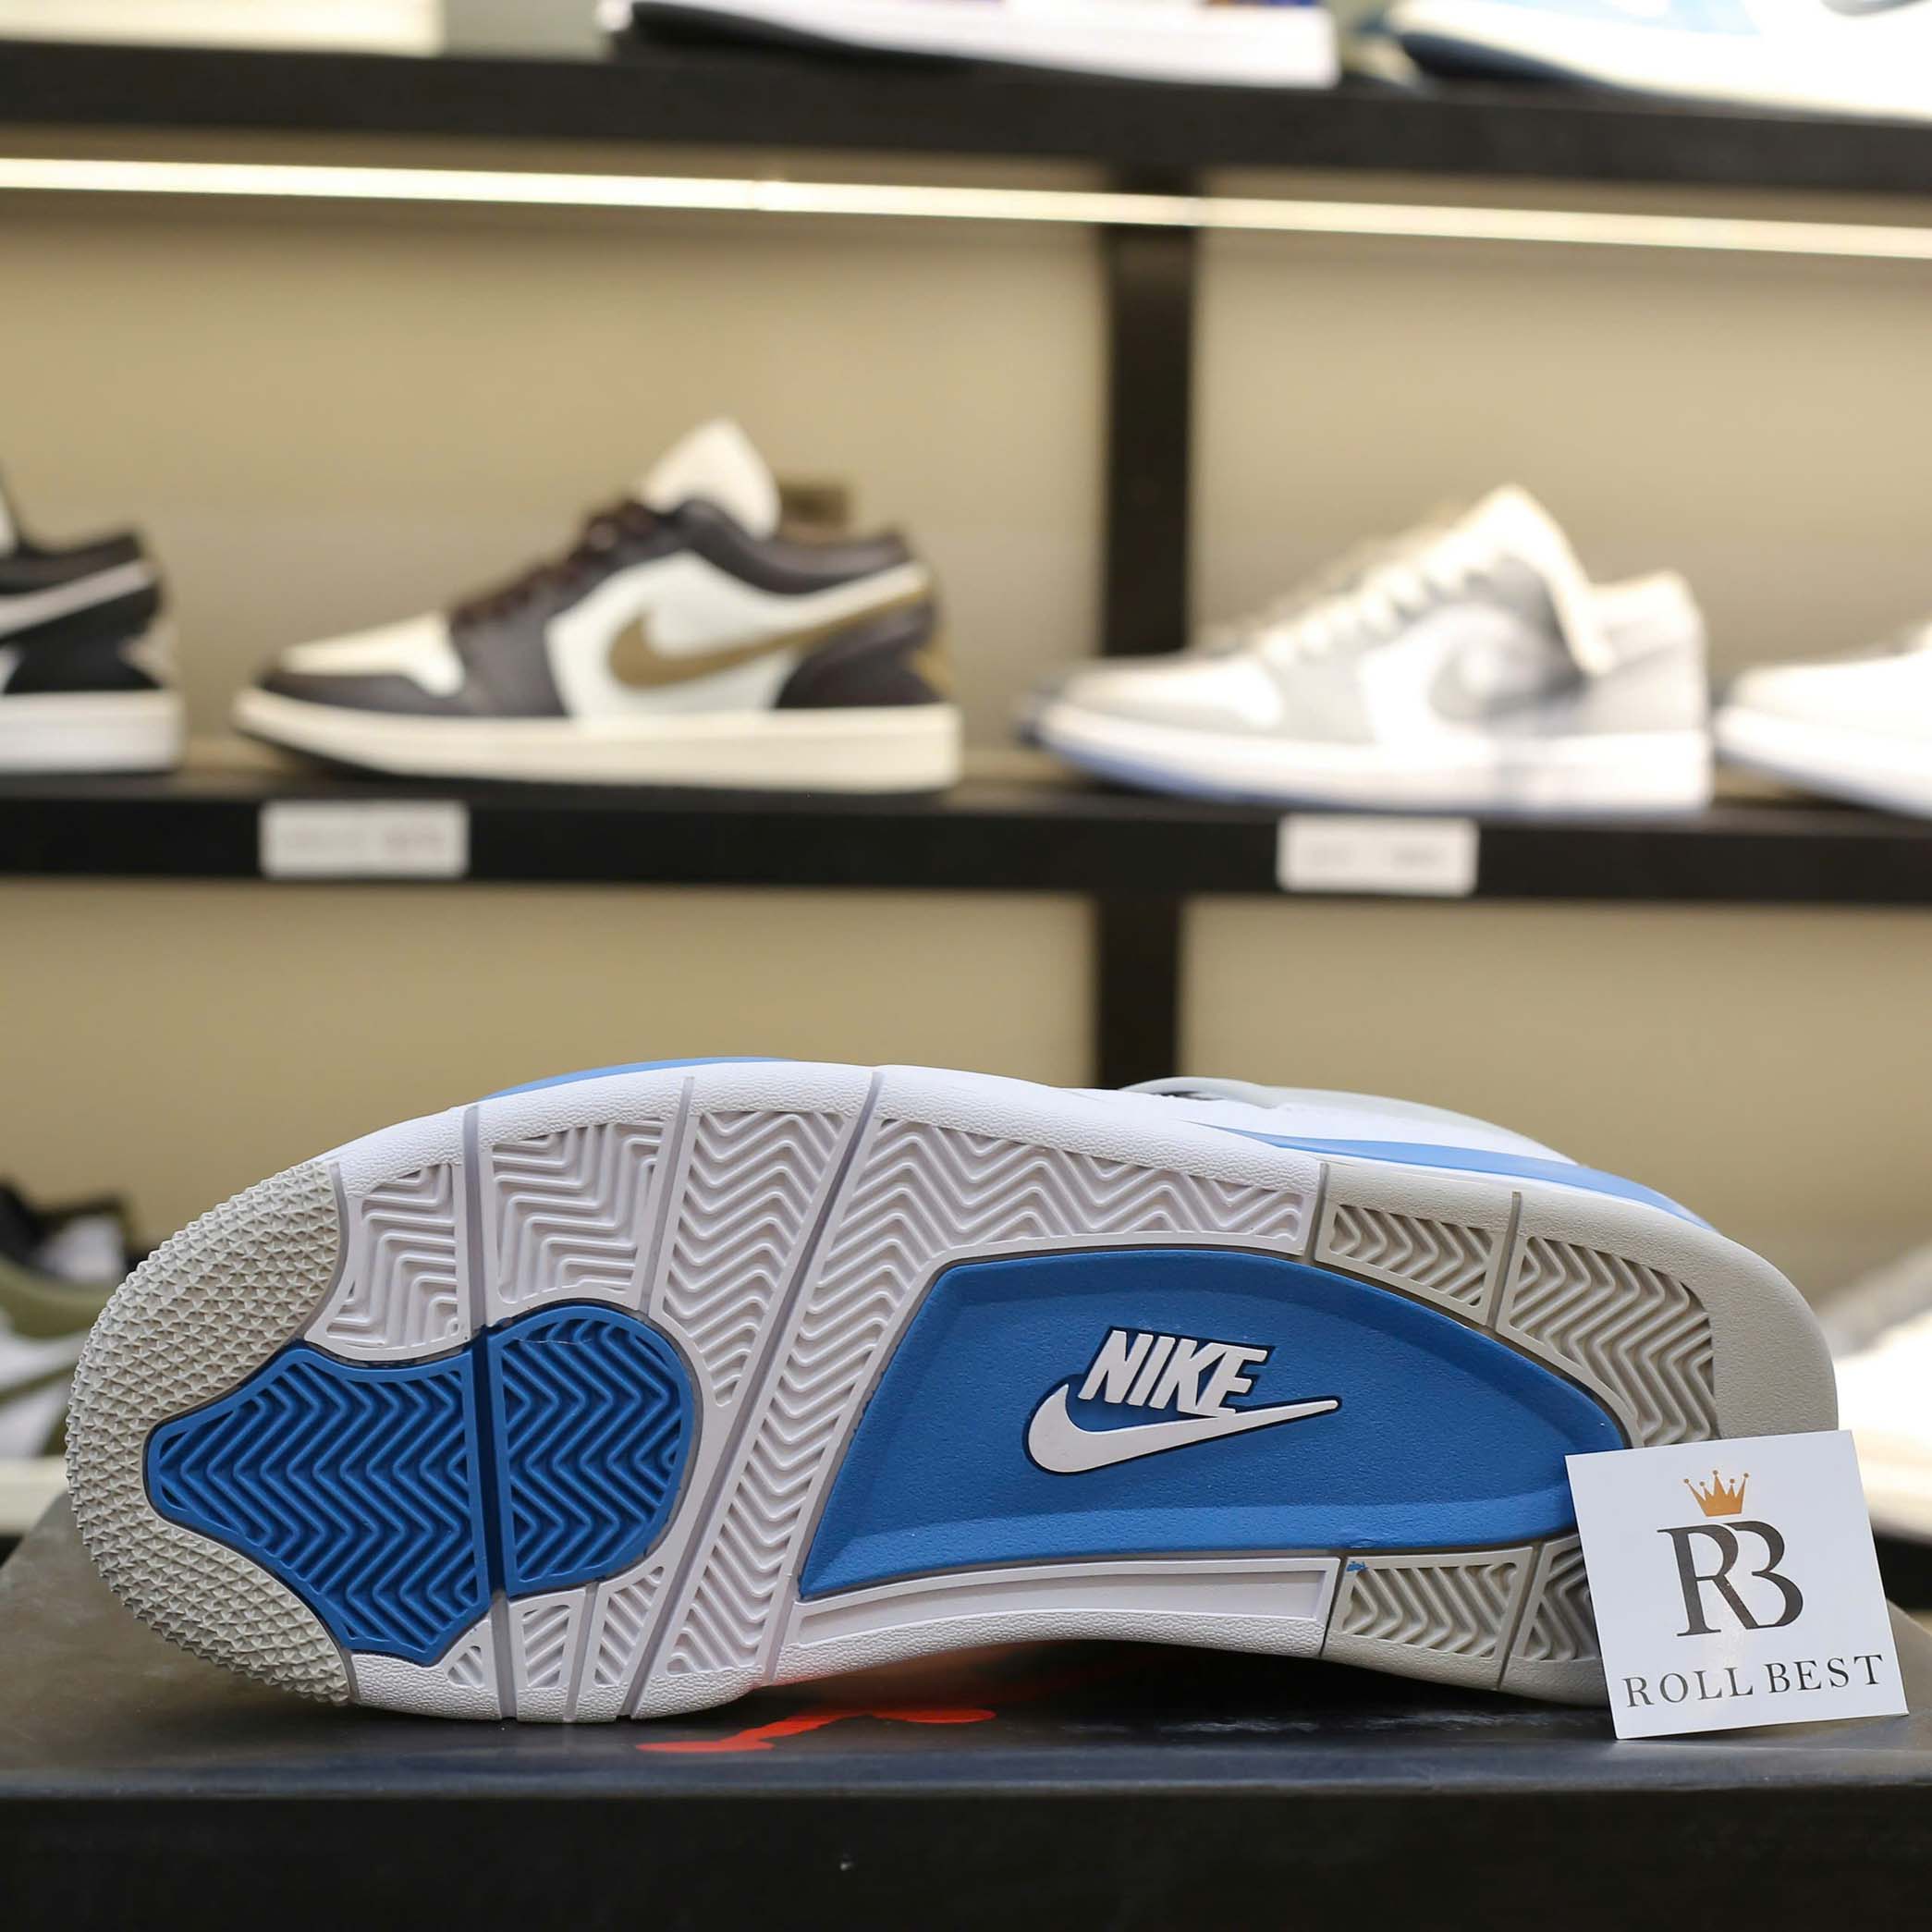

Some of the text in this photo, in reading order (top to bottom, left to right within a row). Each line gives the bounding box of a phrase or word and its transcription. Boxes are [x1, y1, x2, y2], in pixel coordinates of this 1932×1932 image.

[1077, 1329, 1268, 1417] NIKE
[1621, 1654, 1884, 1708] ROLL BEST
